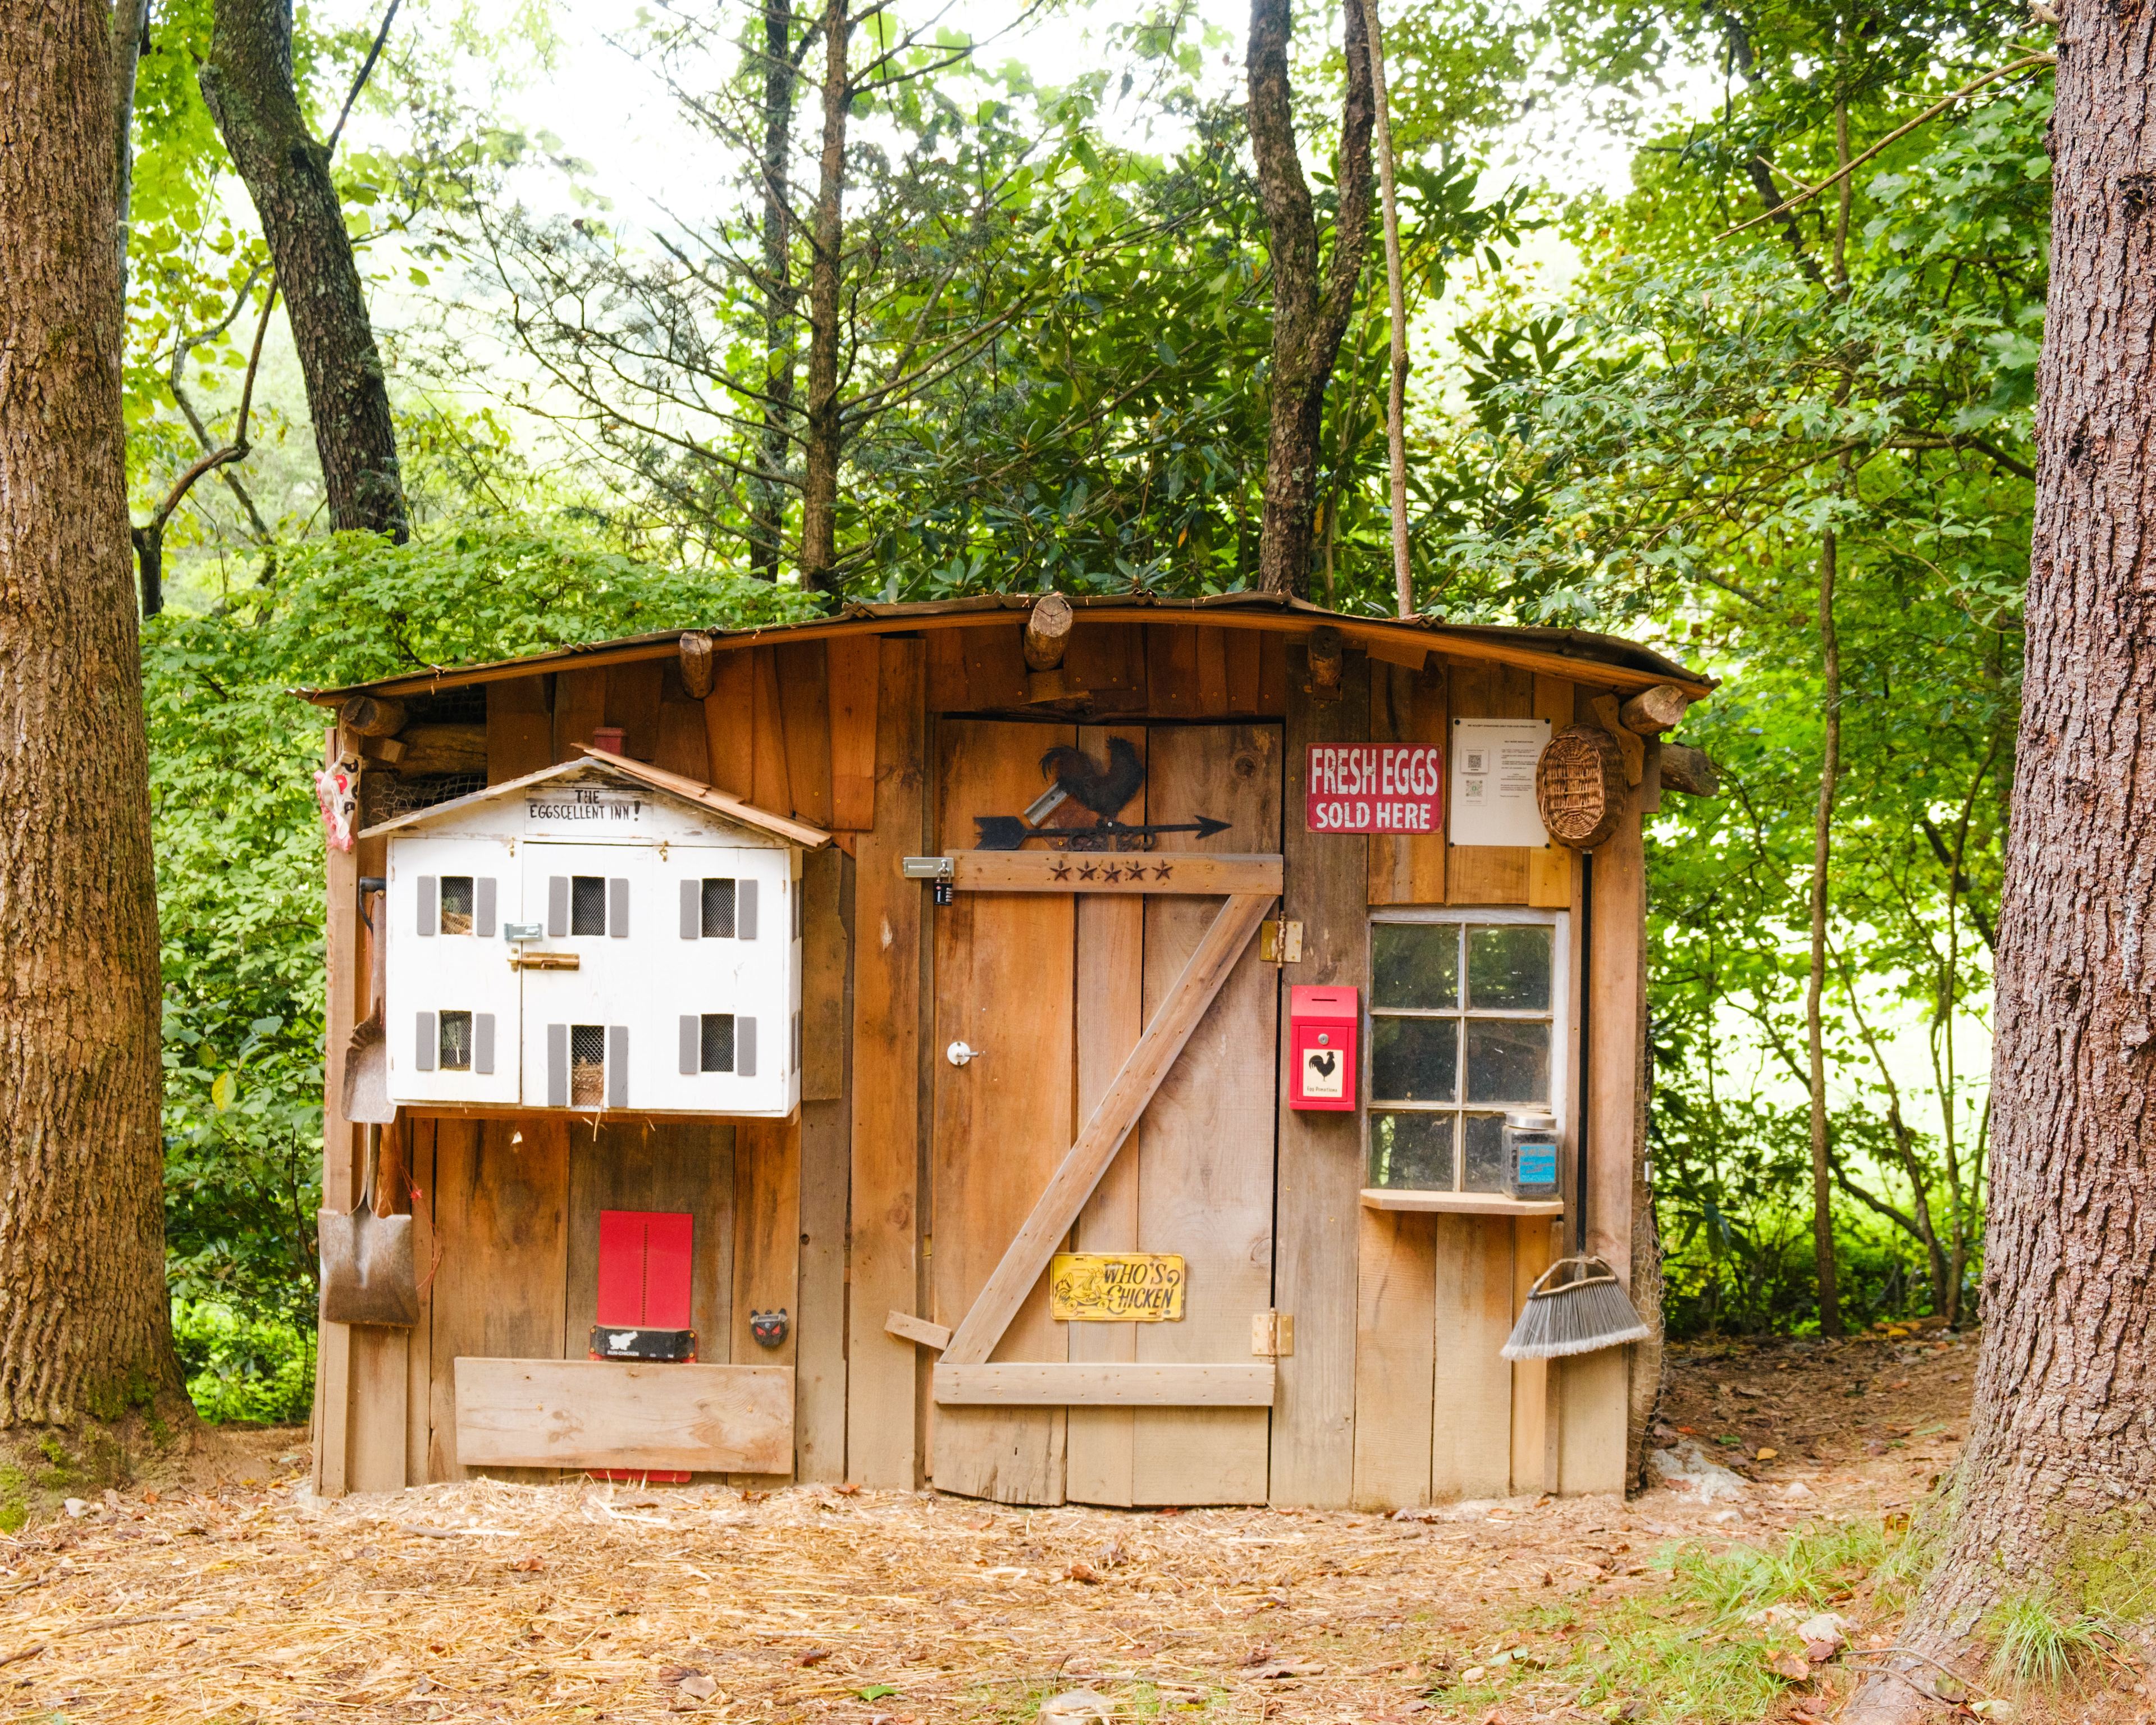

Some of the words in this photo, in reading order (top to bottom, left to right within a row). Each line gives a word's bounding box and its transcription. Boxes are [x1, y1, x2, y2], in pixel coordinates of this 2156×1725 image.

[1311, 748, 1377, 795] FRESH
[1382, 749, 1438, 796] EGGS
[575, 790, 600, 804] THE
[529, 804, 605, 820] EGGSCELLENT
[1315, 802, 1371, 829] SOLD
[1376, 802, 1431, 829] HERE
[1103, 1263, 1168, 1285] WHO'S
